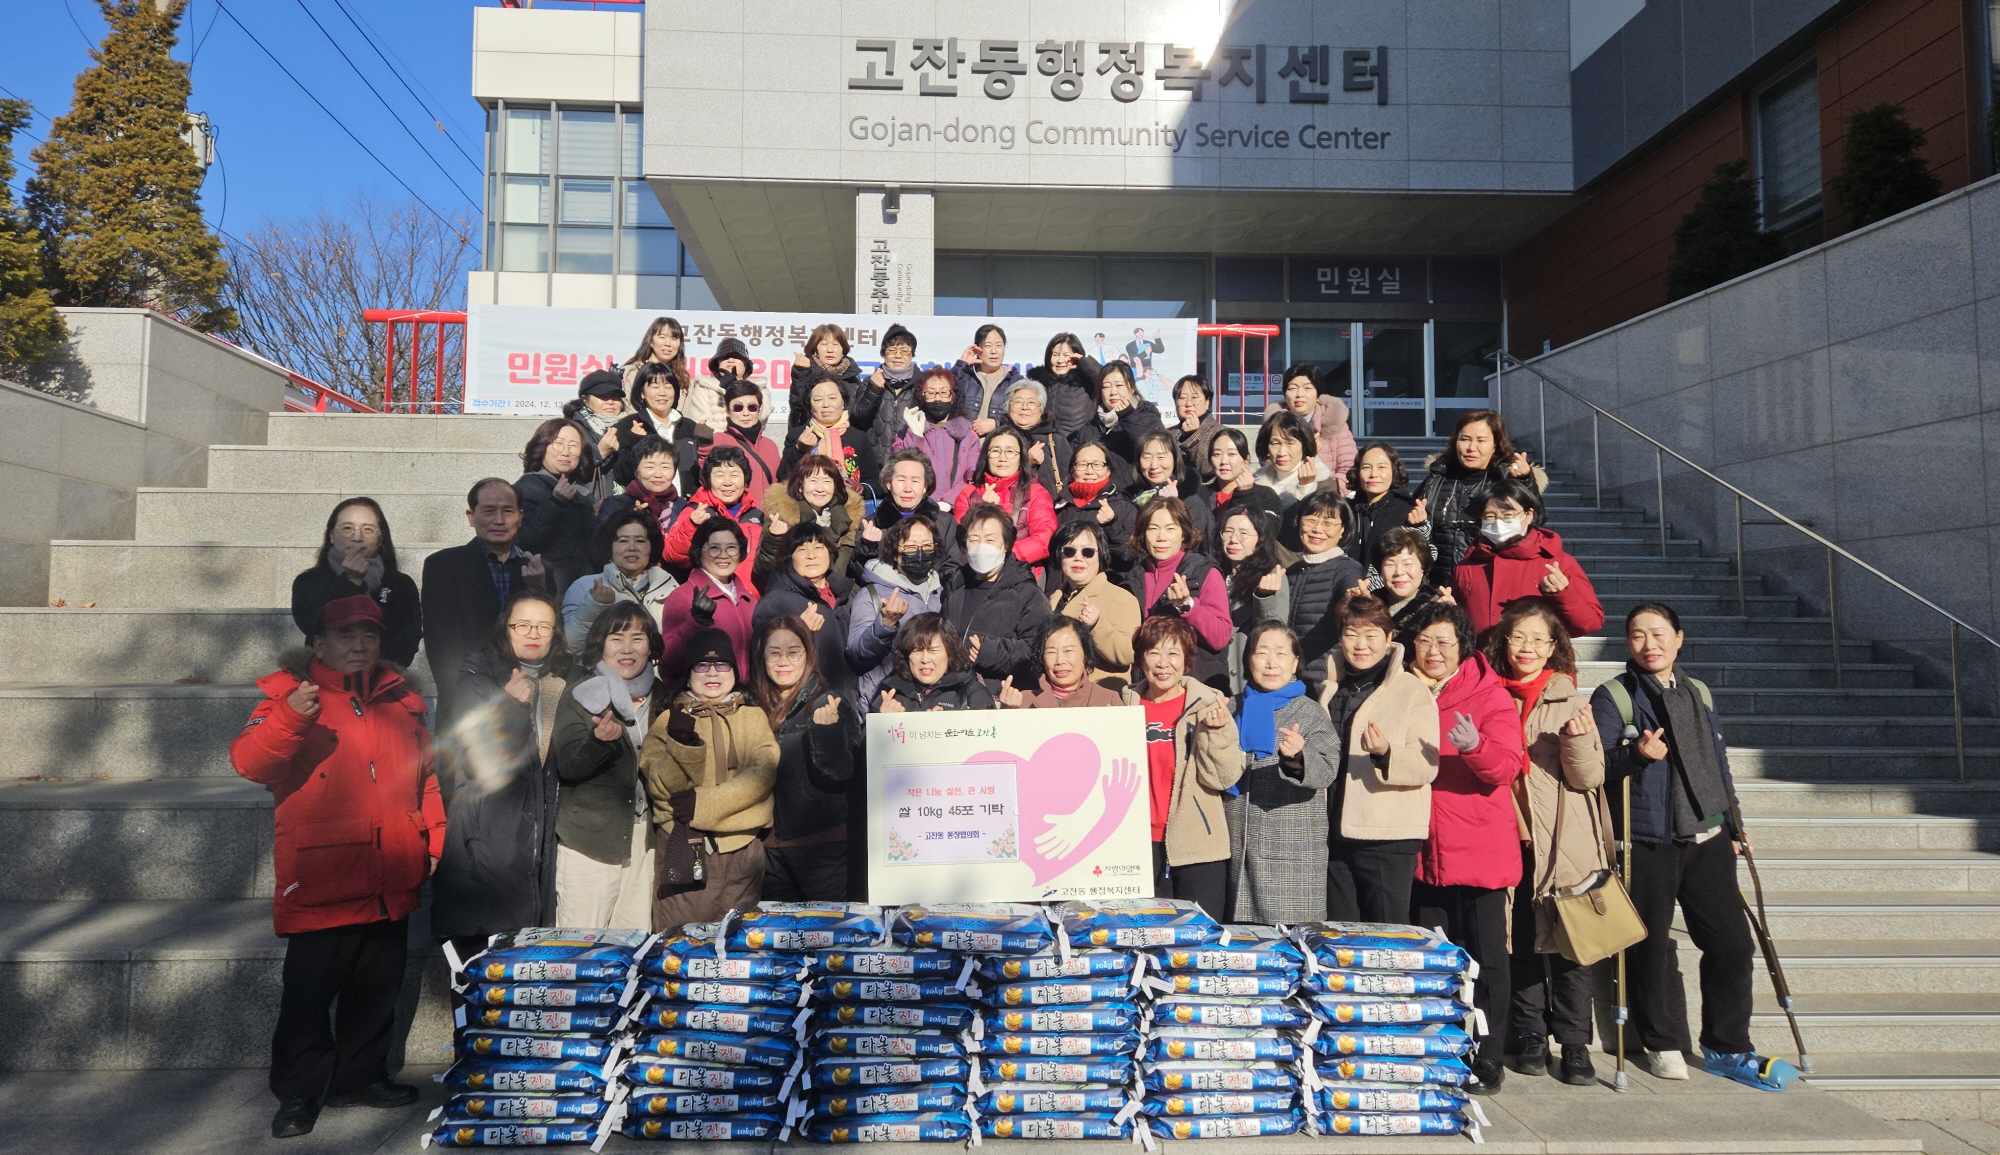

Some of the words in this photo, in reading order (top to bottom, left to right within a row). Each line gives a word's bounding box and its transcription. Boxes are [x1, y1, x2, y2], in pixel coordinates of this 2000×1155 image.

[848, 37, 1389, 105] 고잔동행정복지센터
[849, 115, 1016, 150] Gojan-dong
[1025, 118, 1187, 153] Community
[1195, 122, 1290, 148] Service
[1298, 124, 1391, 150] Center
[1317, 267, 1401, 295] 민원실
[472, 399, 506, 408] 접수기간
[515, 400, 537, 408] 2024.
[919, 730, 942, 740] 넘치는
[907, 788, 923, 797] 작은
[926, 787, 942, 796] 나눔
[968, 786, 976, 796] 큰
[979, 785, 995, 795] 사랑
[899, 806, 911, 818] 쌀
[917, 806, 943, 819] 10kg
[948, 805, 974, 816] 45포
[979, 803, 1004, 816] 기탁
[1061, 887, 1086, 896] 고잔동
[1089, 886, 1140, 895] 행정복지센터
